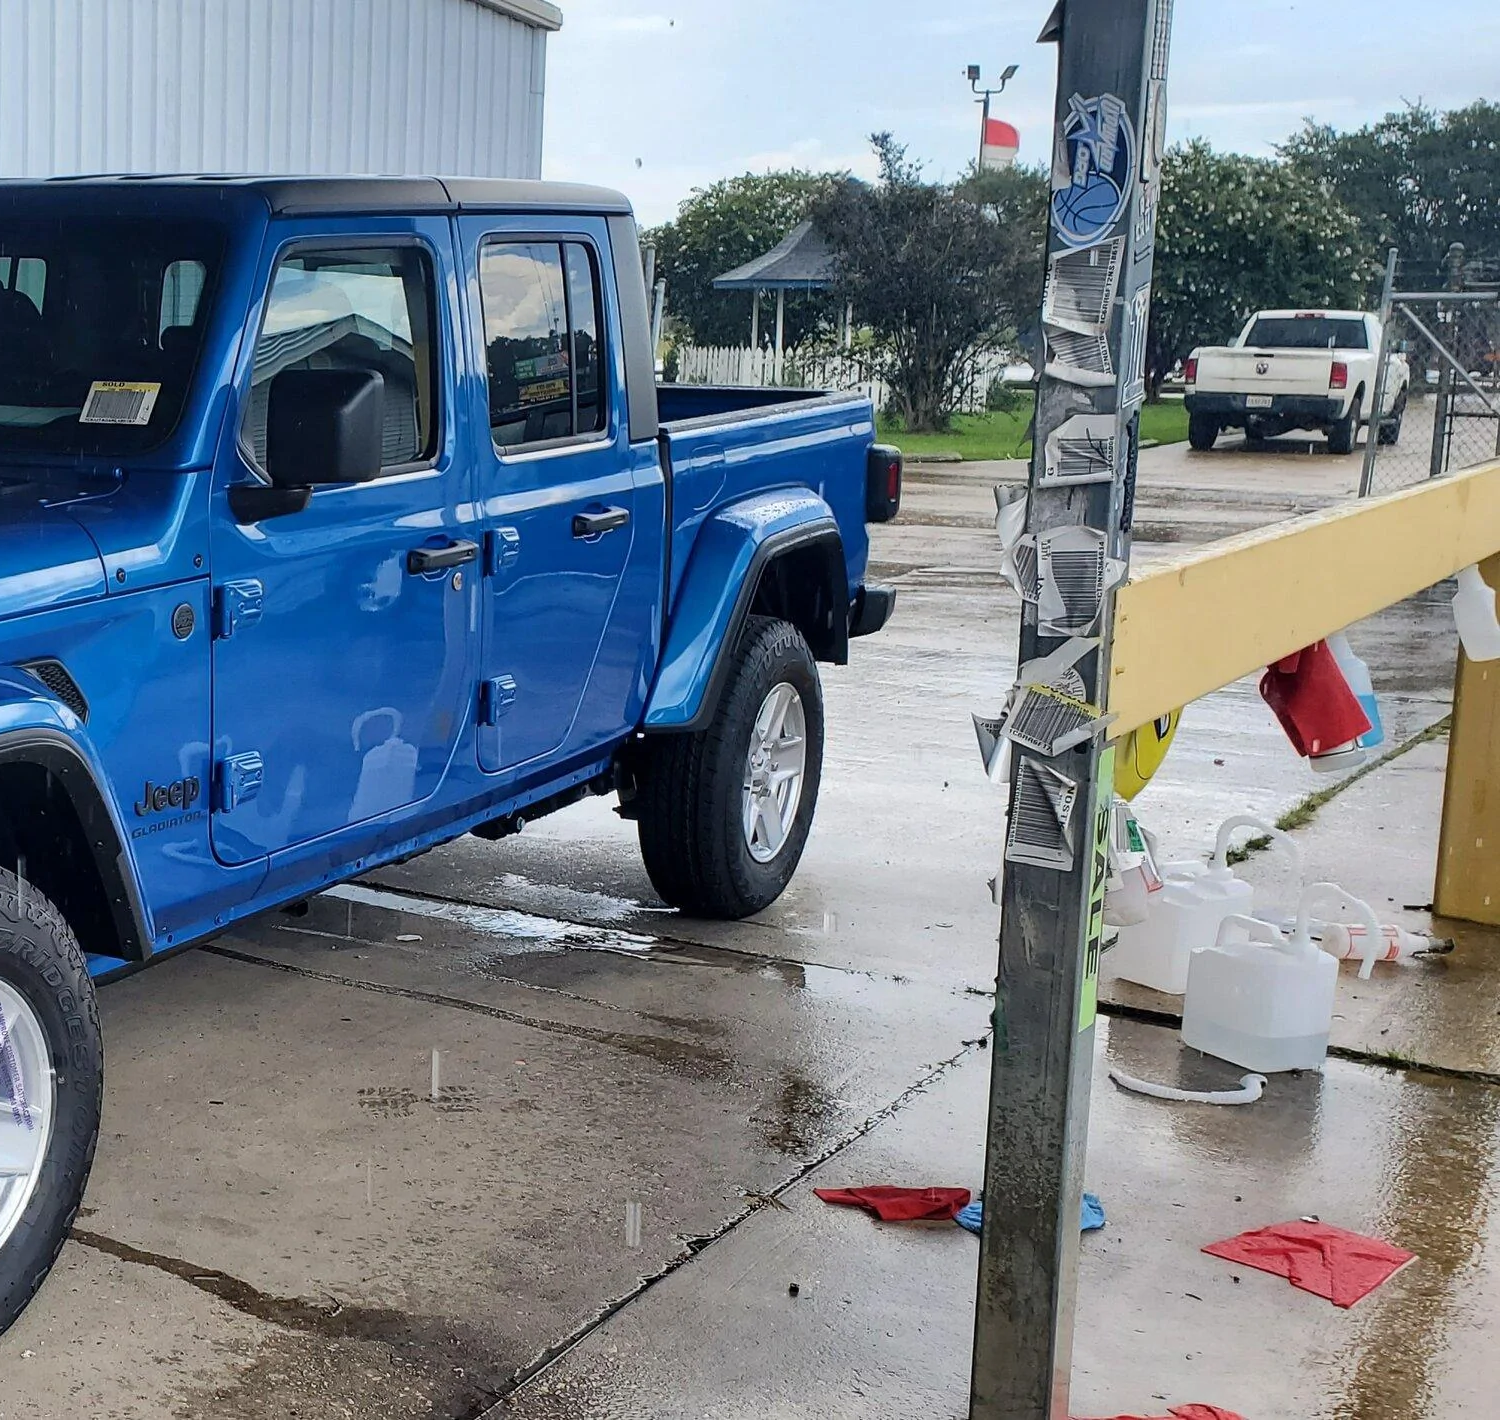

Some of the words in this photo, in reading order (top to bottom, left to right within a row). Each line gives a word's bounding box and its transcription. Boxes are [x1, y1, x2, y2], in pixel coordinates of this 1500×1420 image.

[134, 775, 200, 816] Jeep
[131, 810, 203, 839] GLADIATOR
[1085, 806, 1109, 979] SALE
[3, 1044, 21, 1082] CUSTOMER
